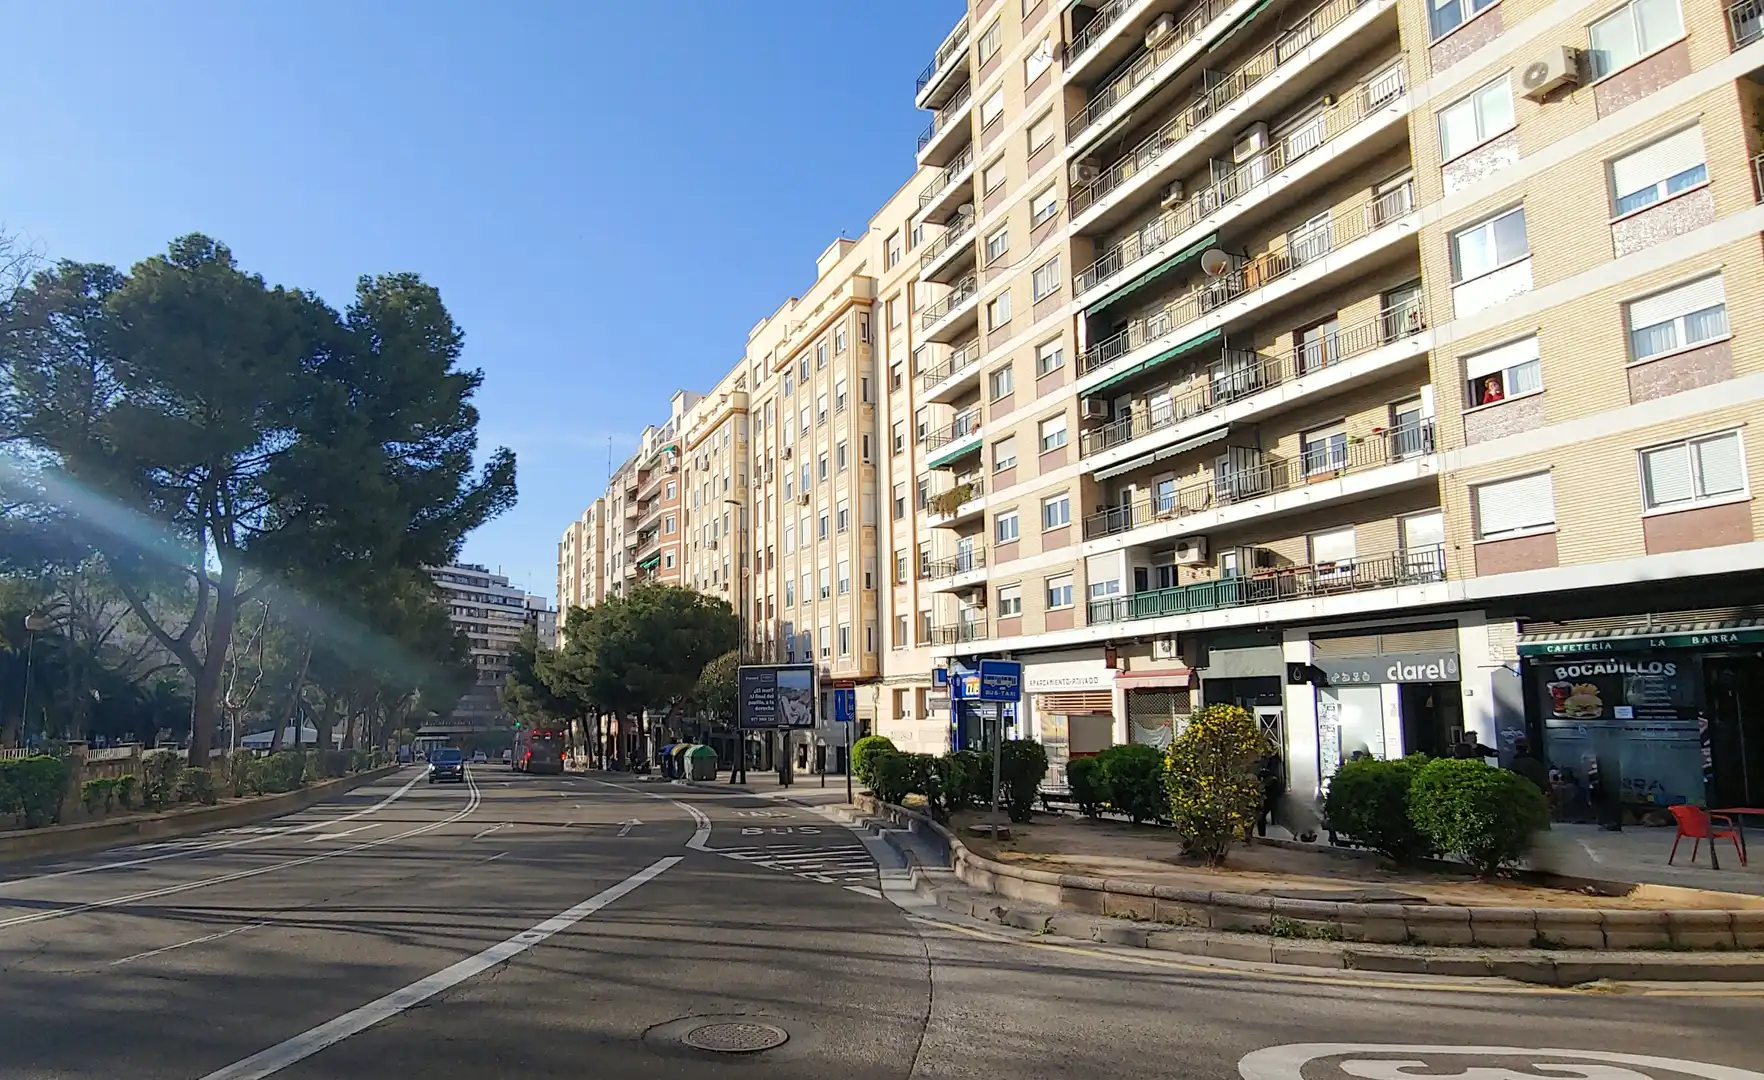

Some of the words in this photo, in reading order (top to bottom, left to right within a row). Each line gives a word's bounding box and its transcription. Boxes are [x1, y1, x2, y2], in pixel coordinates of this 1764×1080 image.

[1650, 639, 1666, 647] LA
[1692, 634, 1738, 644] BARRA
[1386, 658, 1447, 680] clarel
[1554, 661, 1677, 679] BOCADILLOS
[741, 826, 821, 835] BUS
